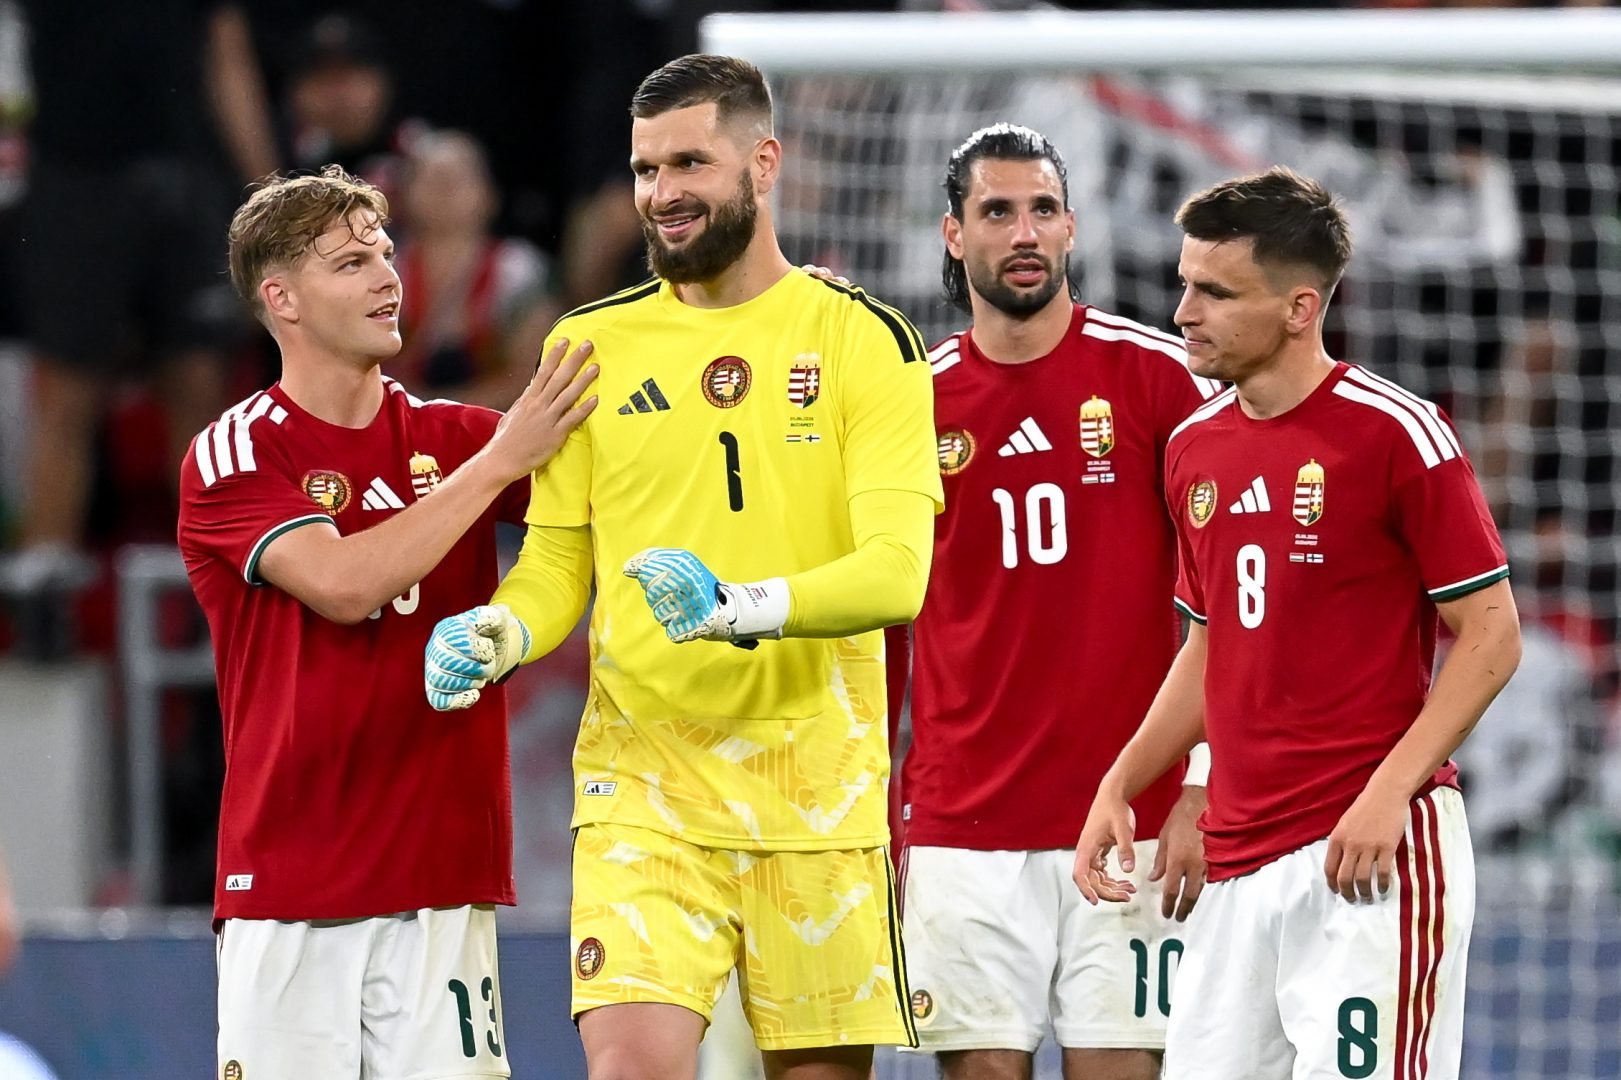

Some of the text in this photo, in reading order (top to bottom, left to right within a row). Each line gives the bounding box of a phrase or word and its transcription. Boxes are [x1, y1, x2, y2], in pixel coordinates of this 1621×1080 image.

[719, 431, 744, 512] 1
[992, 482, 1067, 569] 10
[1236, 544, 1266, 629] 8
[448, 976, 502, 1058] 13
[1130, 938, 1185, 1018] 10
[1337, 996, 1378, 1079] 8
